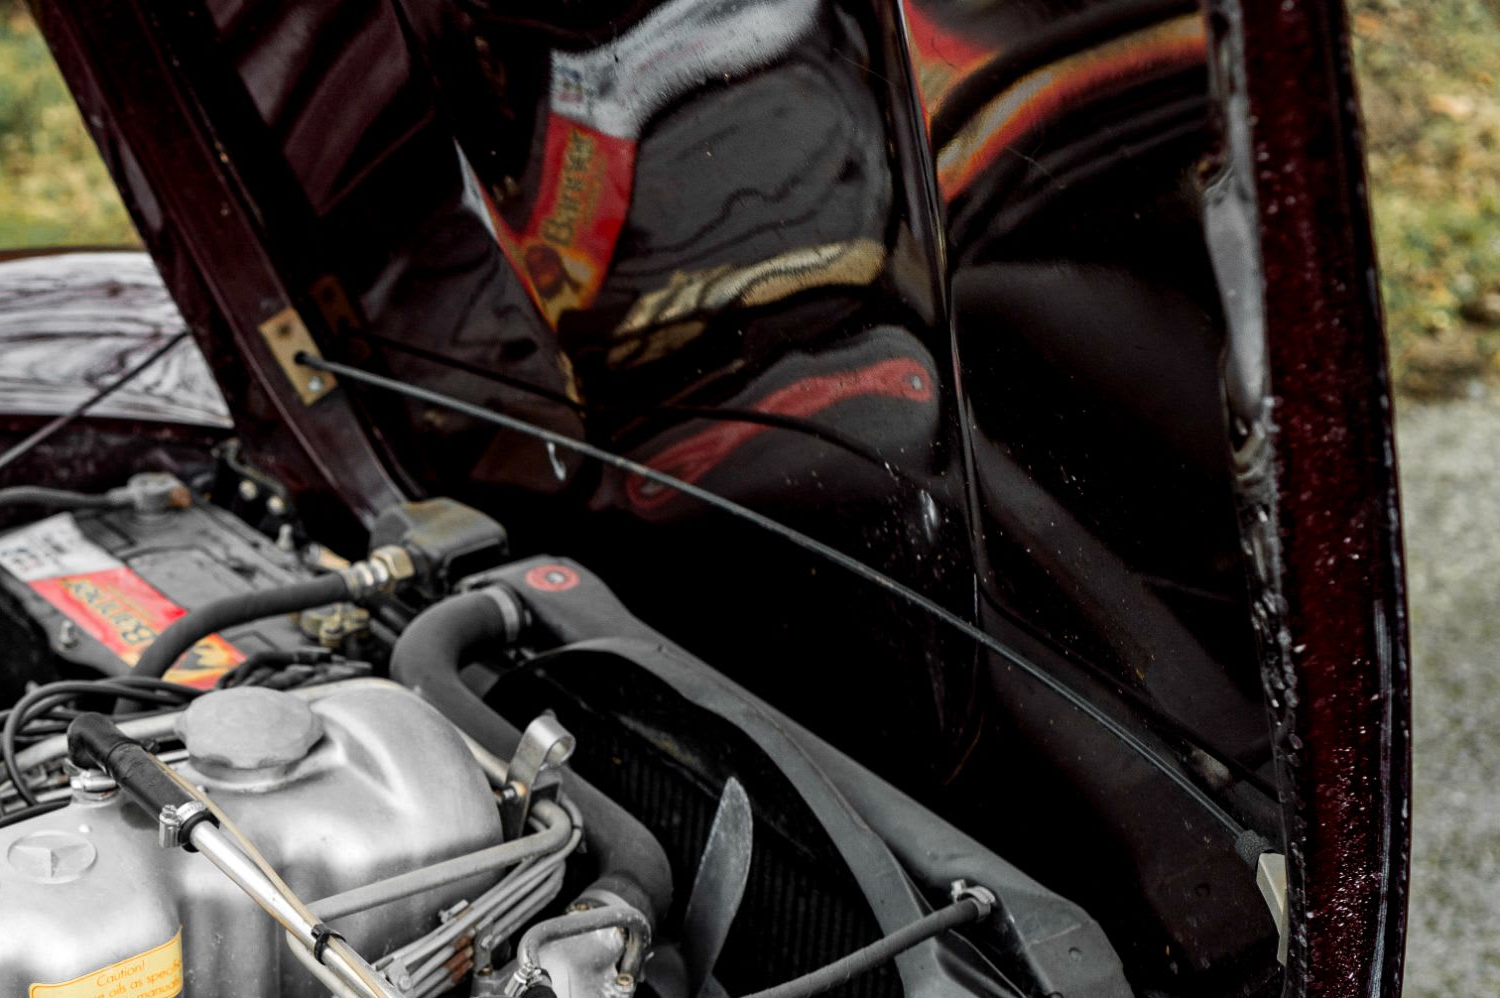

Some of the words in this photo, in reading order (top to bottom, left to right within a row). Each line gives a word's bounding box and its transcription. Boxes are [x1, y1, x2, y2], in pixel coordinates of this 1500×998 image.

[96, 960, 145, 988] Caution!
[109, 983, 126, 998] oils
[130, 980, 143, 990] as
